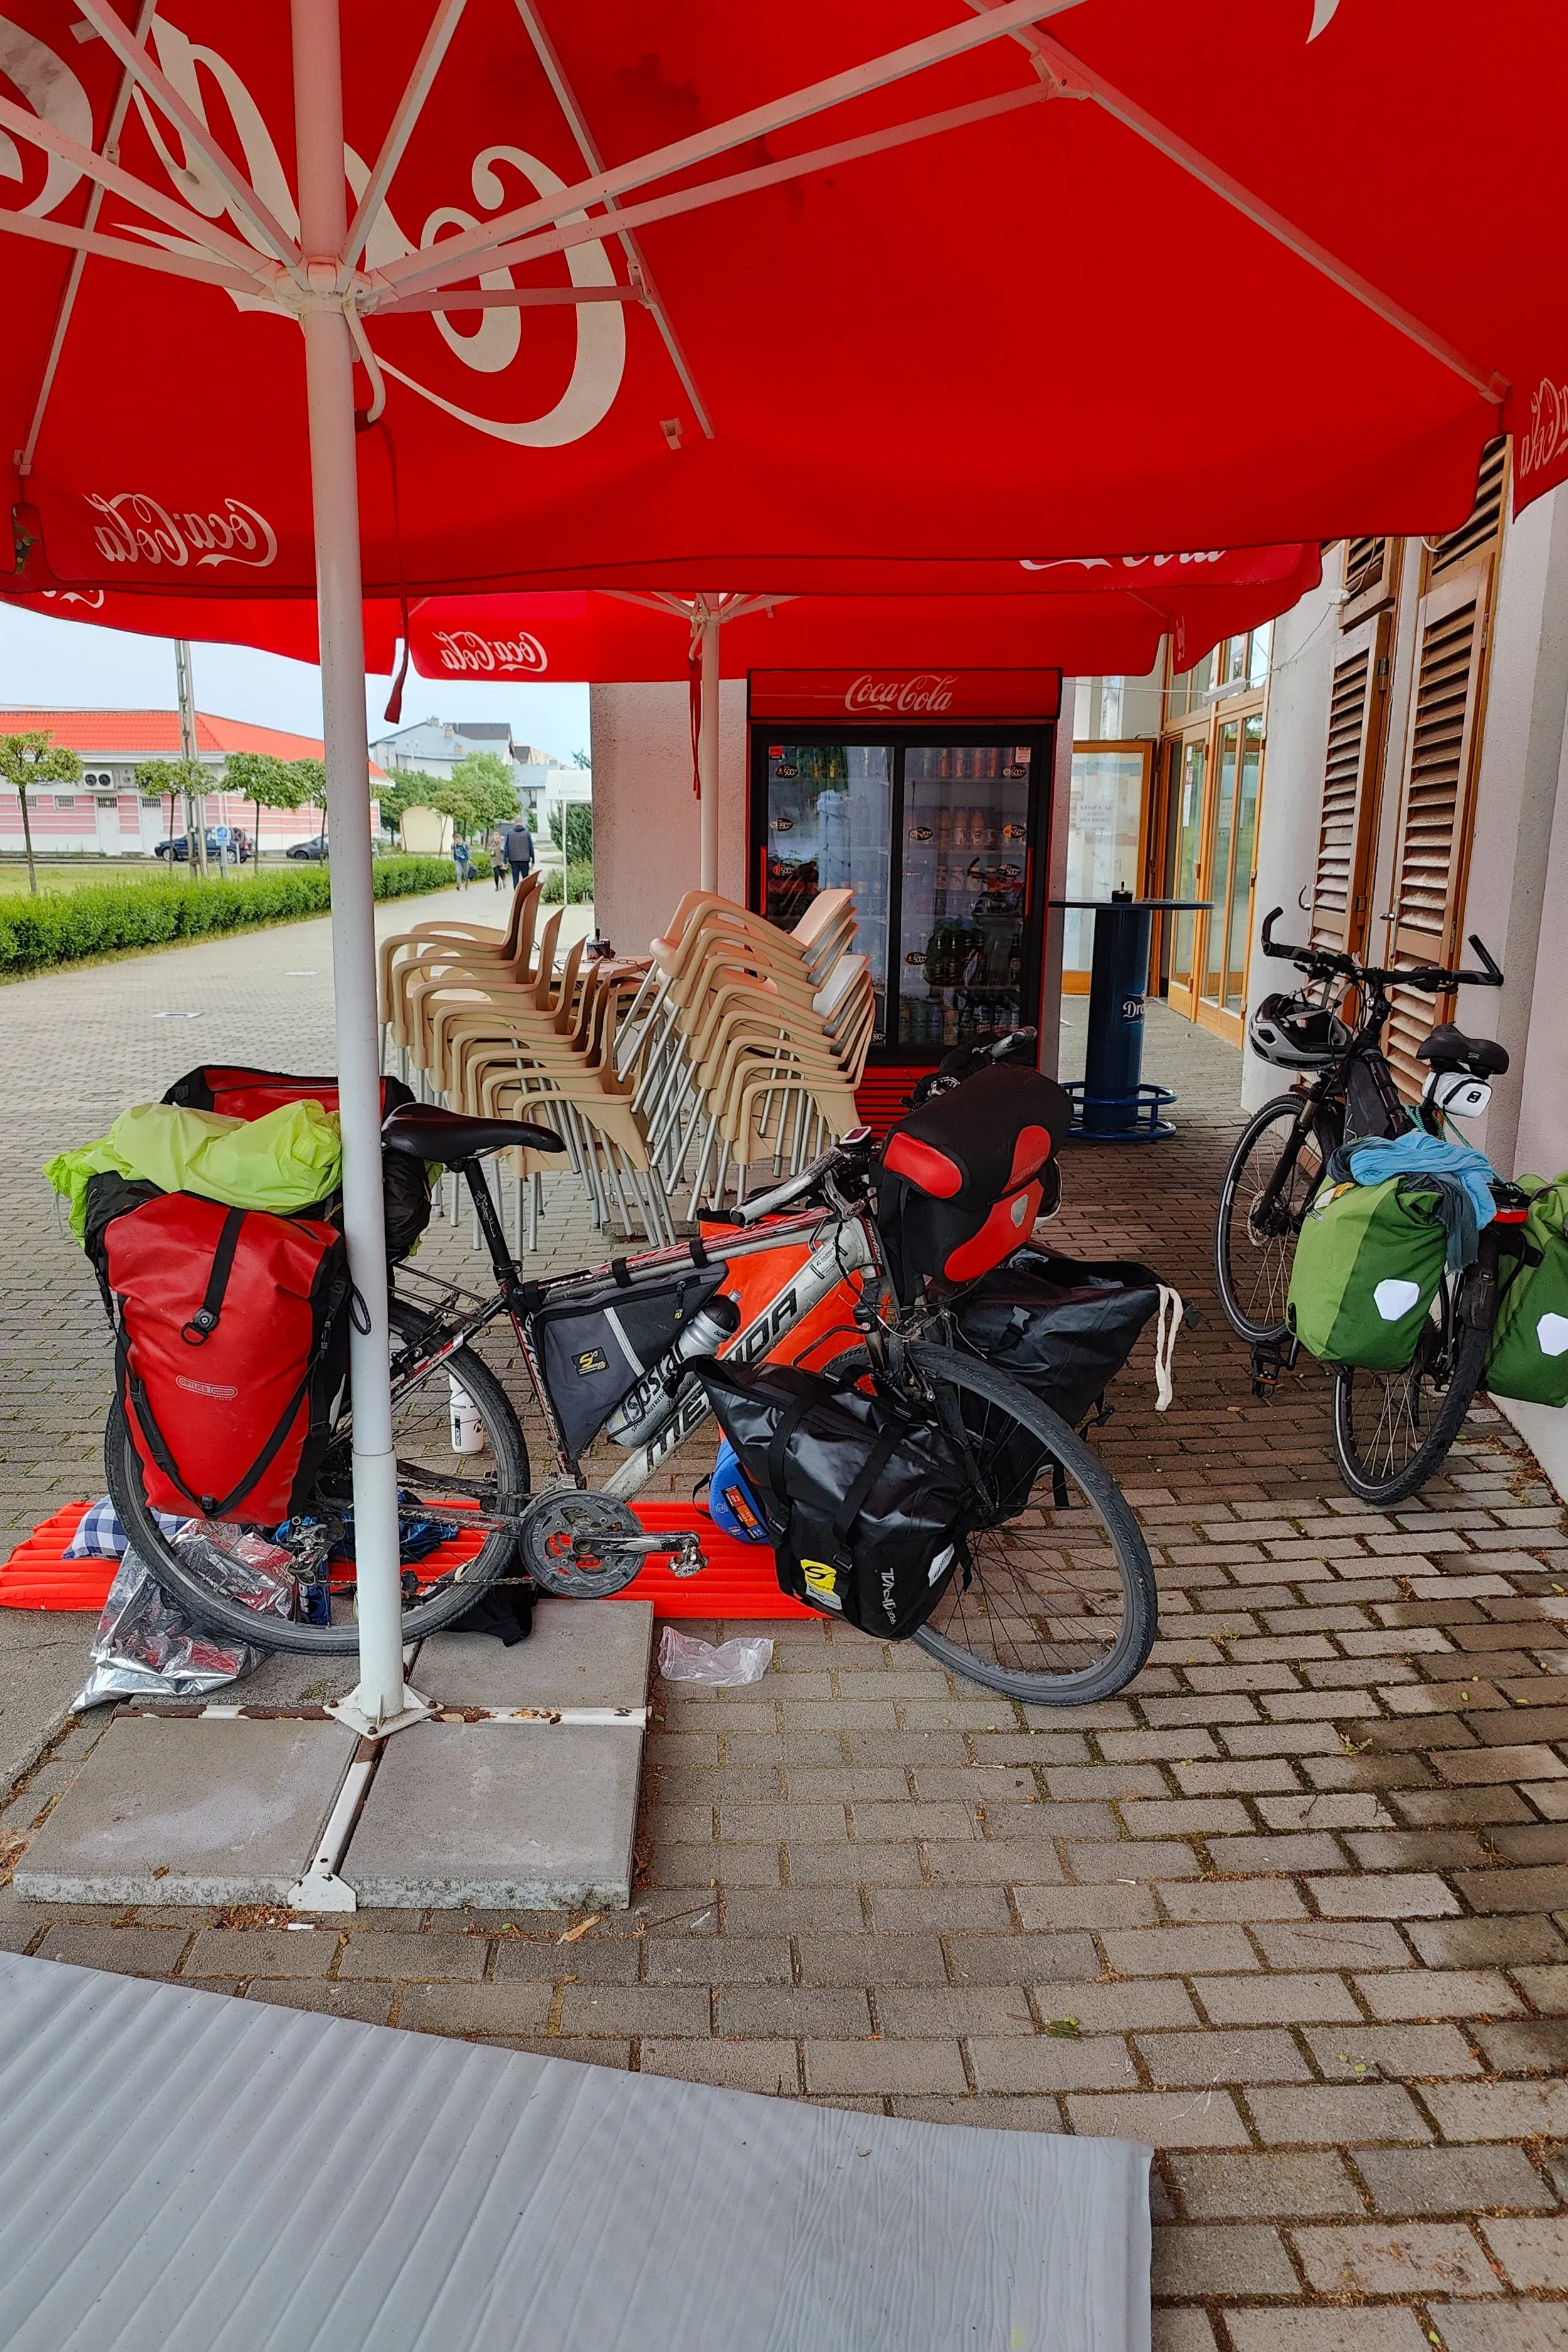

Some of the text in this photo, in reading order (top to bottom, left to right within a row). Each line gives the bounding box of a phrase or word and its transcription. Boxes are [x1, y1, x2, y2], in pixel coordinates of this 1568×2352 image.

[845, 675, 958, 712] Coca-Cola
[1123, 1001, 1144, 1018] Dre
[179, 1379, 208, 1392] ORTLIEB
[647, 1288, 798, 1473] MEIDA
[645, 1391, 666, 1416] NUTRITIO
